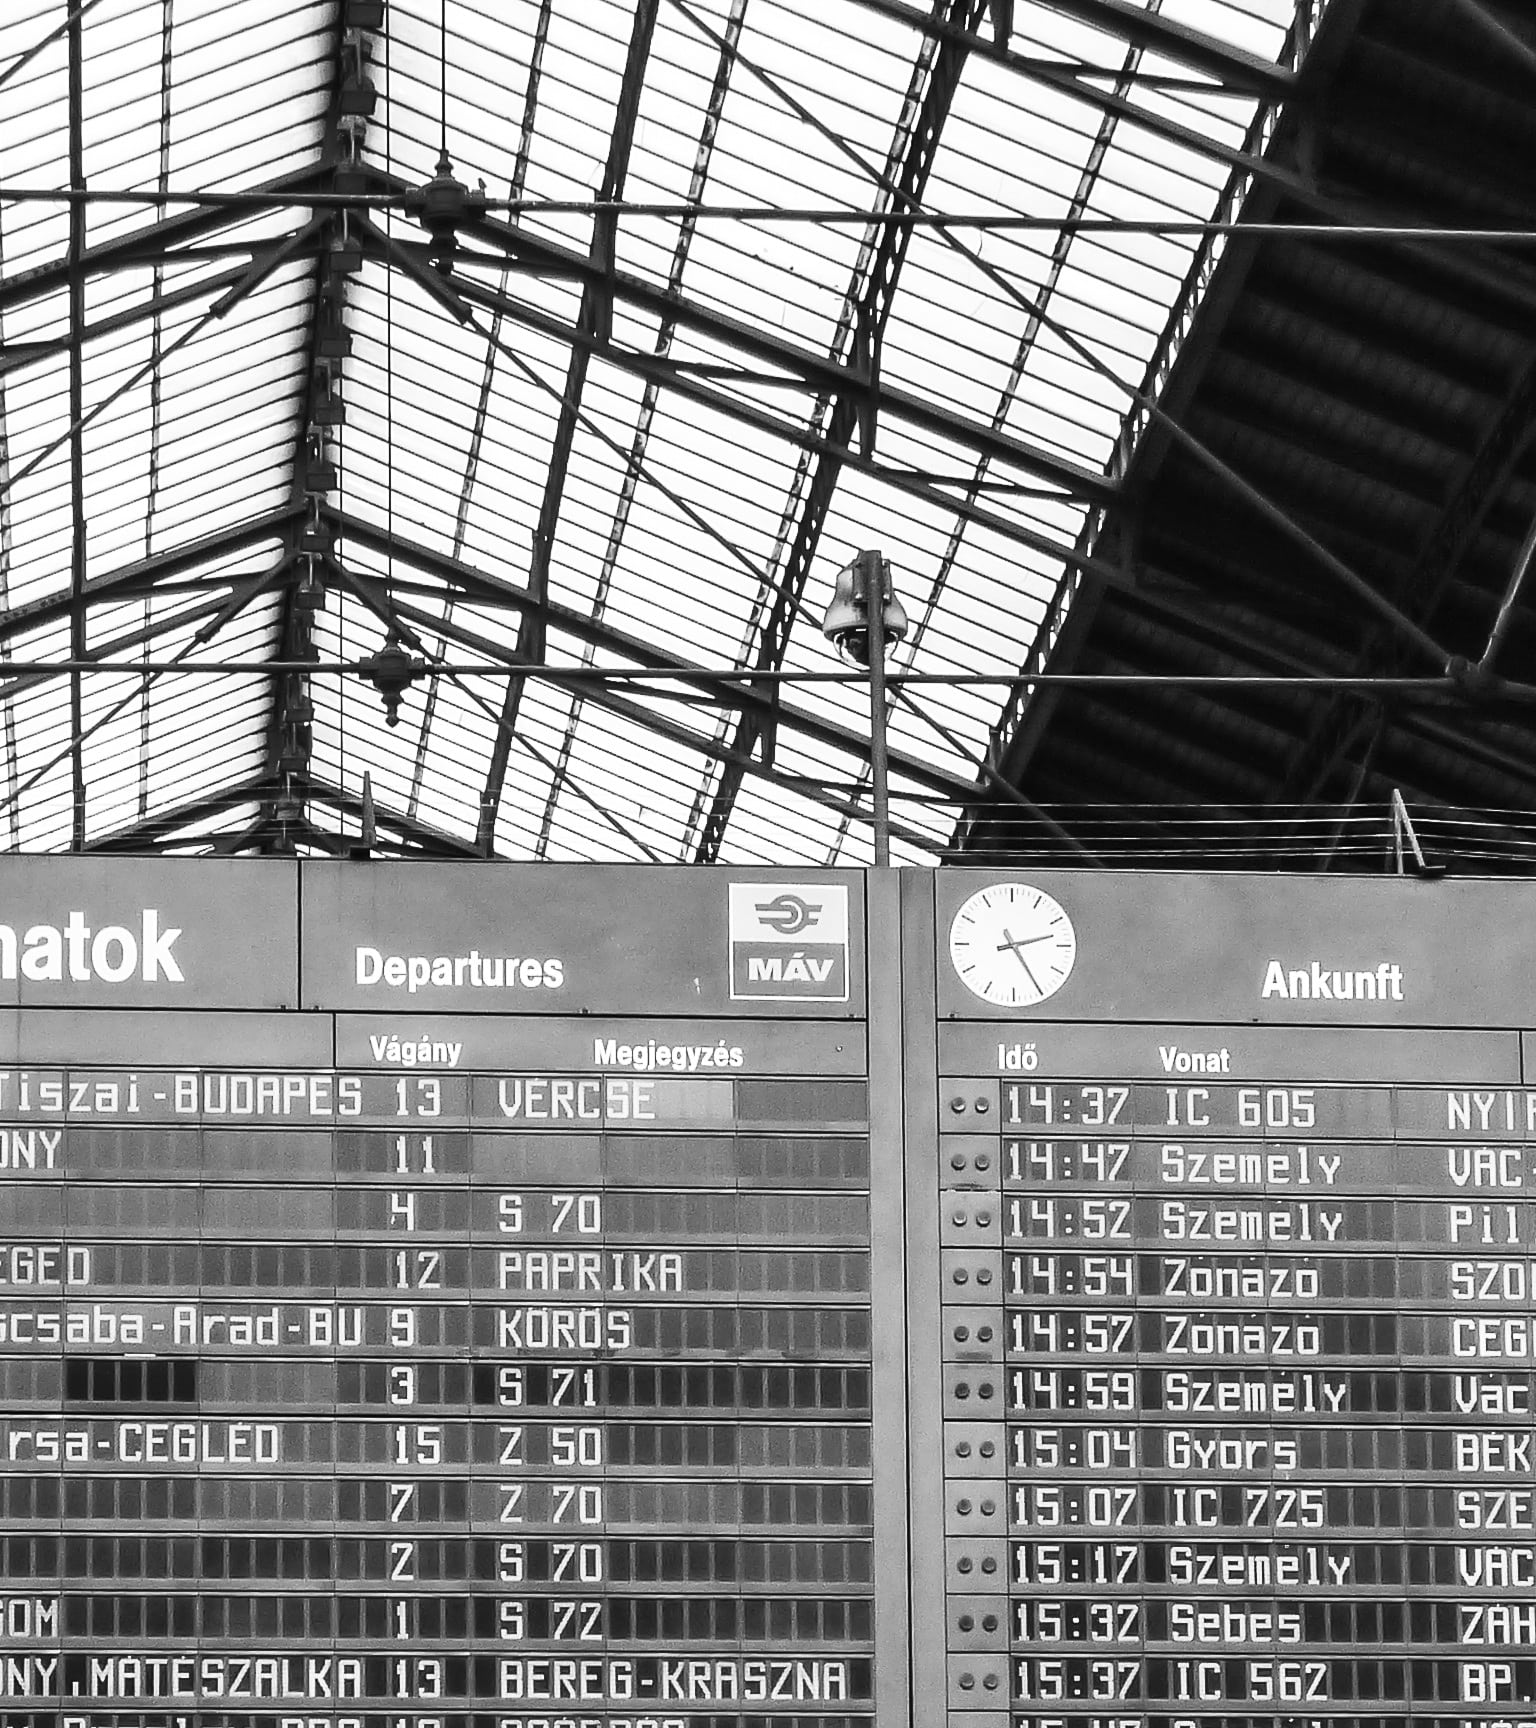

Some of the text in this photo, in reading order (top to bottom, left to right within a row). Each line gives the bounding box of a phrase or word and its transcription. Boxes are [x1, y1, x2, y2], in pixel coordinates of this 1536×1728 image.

[356, 946, 564, 993] Departures
[748, 952, 834, 982] MÁV
[1261, 960, 1404, 1002] Ankunft
[370, 1034, 462, 1067] Vágány
[594, 1038, 744, 1071] Megjegyzés
[997, 1041, 1038, 1072] Idő
[1159, 1048, 1231, 1074] Vonat
[394, 1078, 439, 1116] 13
[1009, 1086, 1132, 1125] 14:37
[1166, 1089, 1211, 1126] IC
[1240, 1090, 1316, 1128] 605
[394, 1136, 435, 1174] 11
[1009, 1143, 1133, 1181] 14:47
[497, 1194, 521, 1232] S
[551, 1195, 601, 1233] 70
[1010, 1200, 1134, 1238] 14:52
[395, 1251, 440, 1289] 12
[497, 1252, 682, 1291] PAPRIKA
[1011, 1257, 1135, 1295] 14:54
[390, 1309, 413, 1346] 9
[1012, 1314, 1136, 1352] 14:57
[390, 1367, 413, 1404] 3
[498, 1367, 522, 1405] S
[552, 1368, 597, 1406] 71
[1012, 1371, 1137, 1410] 14:59
[395, 1425, 441, 1463] 15
[552, 1426, 603, 1464] 50
[1013, 1428, 1138, 1467] 15:04
[1167, 1430, 1297, 1469] Gyors
[390, 1483, 414, 1521] 7
[553, 1484, 603, 1522] 70
[1014, 1486, 1139, 1525] 15:07
[1173, 1488, 1219, 1526] IC
[1248, 1488, 1324, 1526] 725
[390, 1541, 414, 1579] 2
[553, 1542, 604, 1580] 70
[1015, 1544, 1140, 1583] 15:17
[553, 1601, 604, 1639] 72
[1015, 1602, 1141, 1641] 15:32
[1170, 1603, 1300, 1642] Sebes
[396, 1659, 442, 1697] 13
[500, 1659, 848, 1698] BEREG-KRASZNA
[1016, 1660, 1142, 1699] 15:37
[1176, 1661, 1222, 1700] IC
[1251, 1662, 1328, 1700] 562
